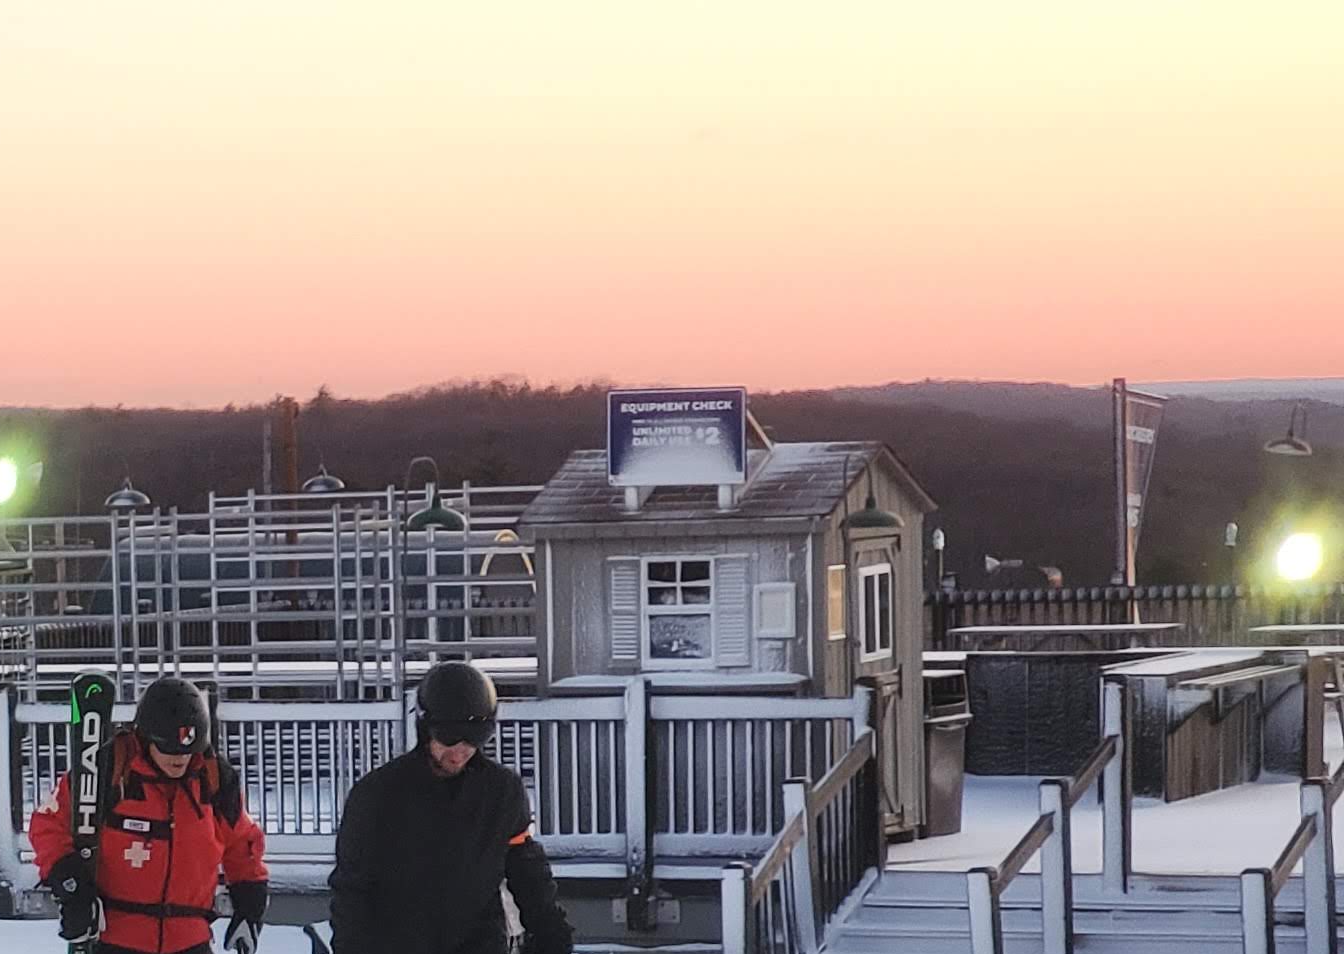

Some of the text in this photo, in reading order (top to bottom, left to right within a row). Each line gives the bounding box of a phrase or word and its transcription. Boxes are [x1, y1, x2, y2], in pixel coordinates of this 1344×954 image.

[620, 400, 733, 414] EQUIPMENT CHECK
[632, 426, 692, 436] UNLIMITED
[77, 711, 101, 835] HEAD
